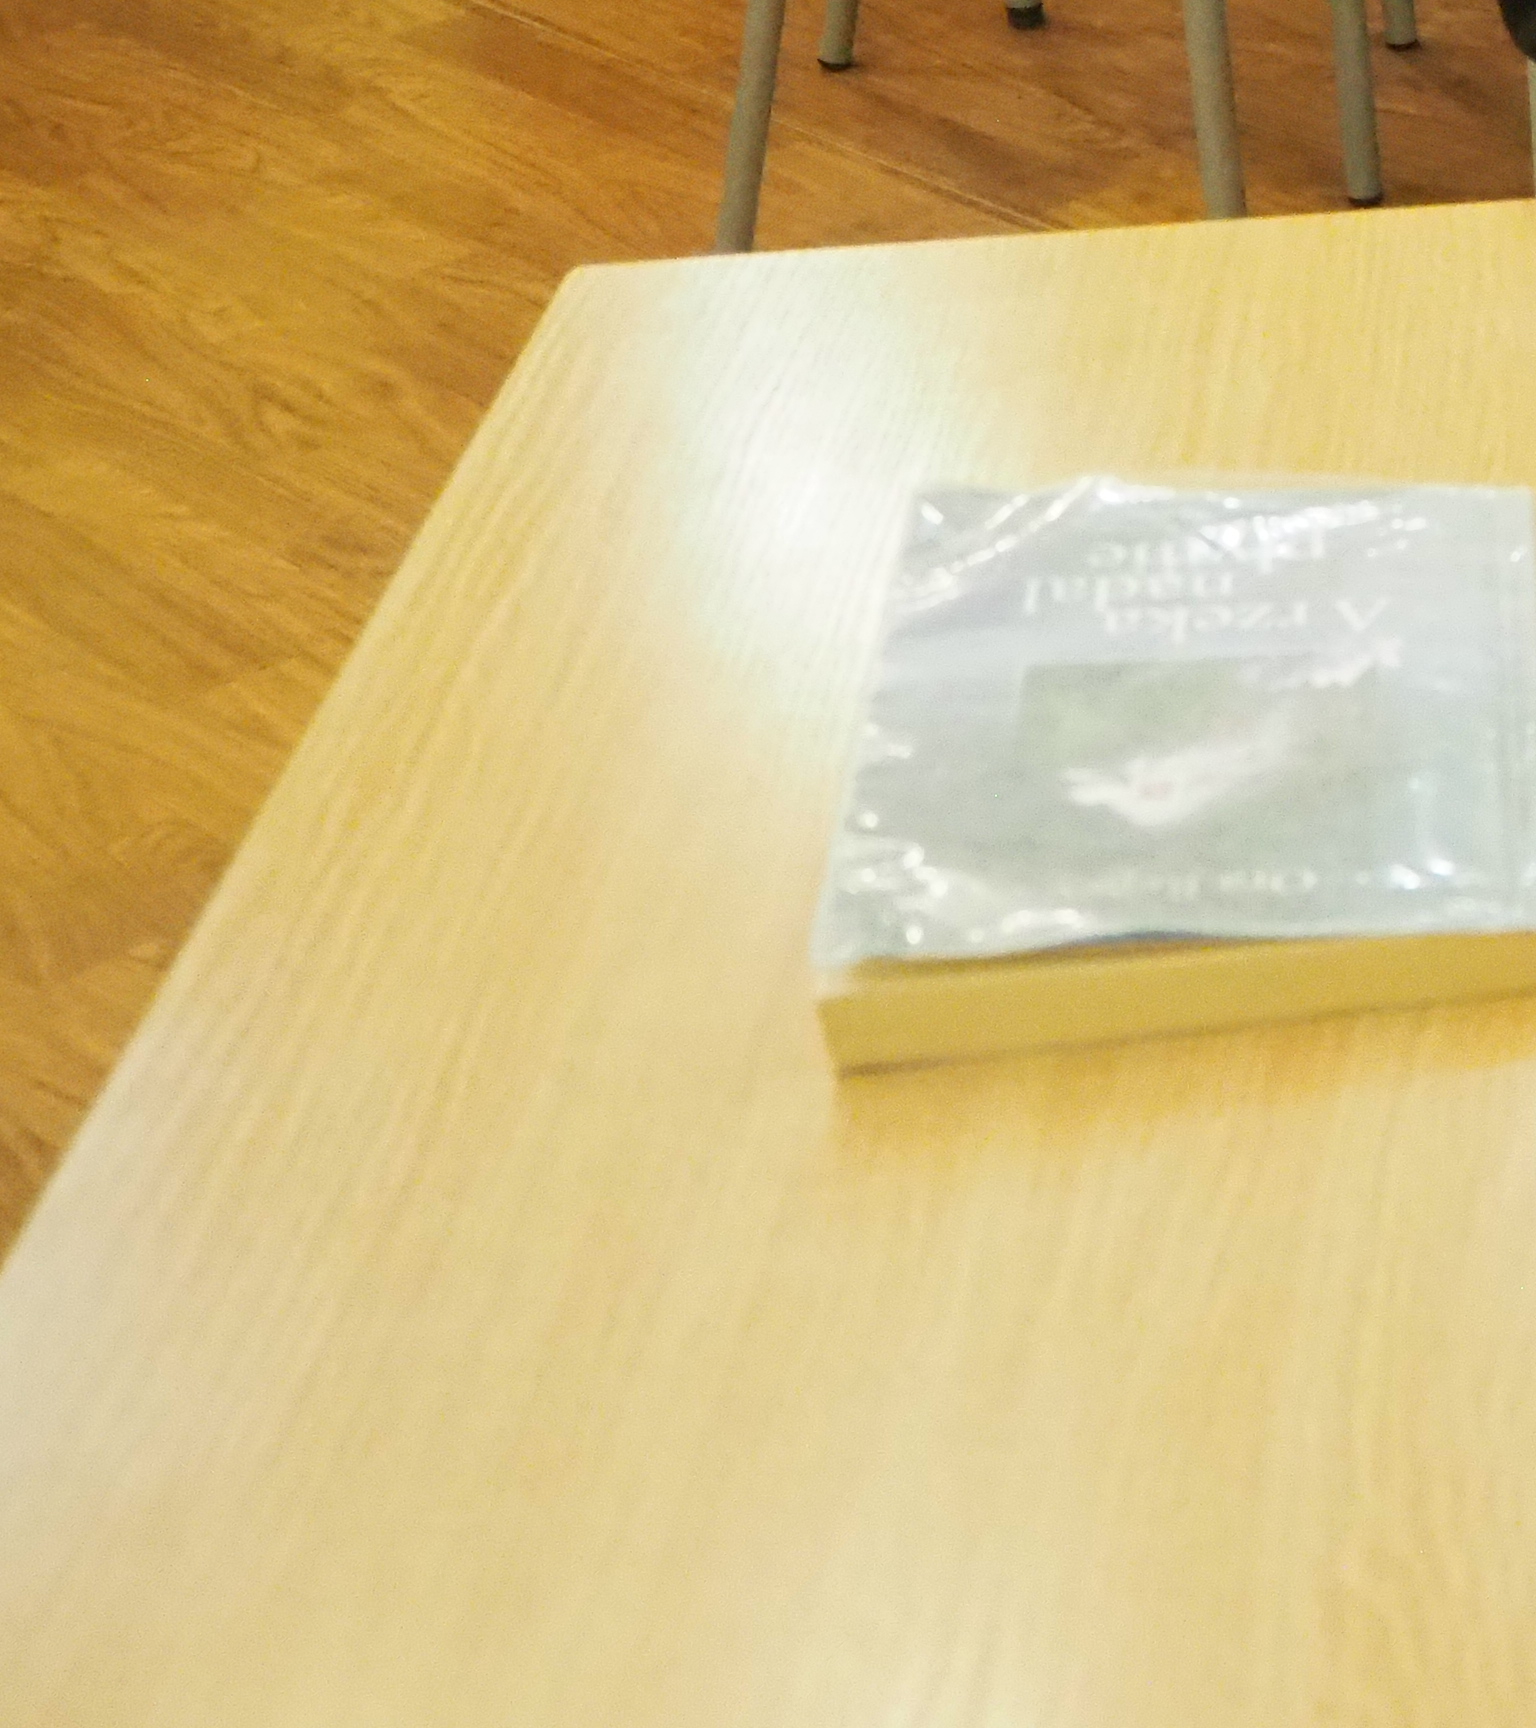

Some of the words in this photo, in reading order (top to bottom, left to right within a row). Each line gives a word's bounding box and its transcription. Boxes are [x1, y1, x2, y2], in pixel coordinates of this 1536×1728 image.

[1023, 572, 1236, 617] nadal
[1335, 597, 1389, 631] A
[1099, 598, 1310, 645] rzeka
